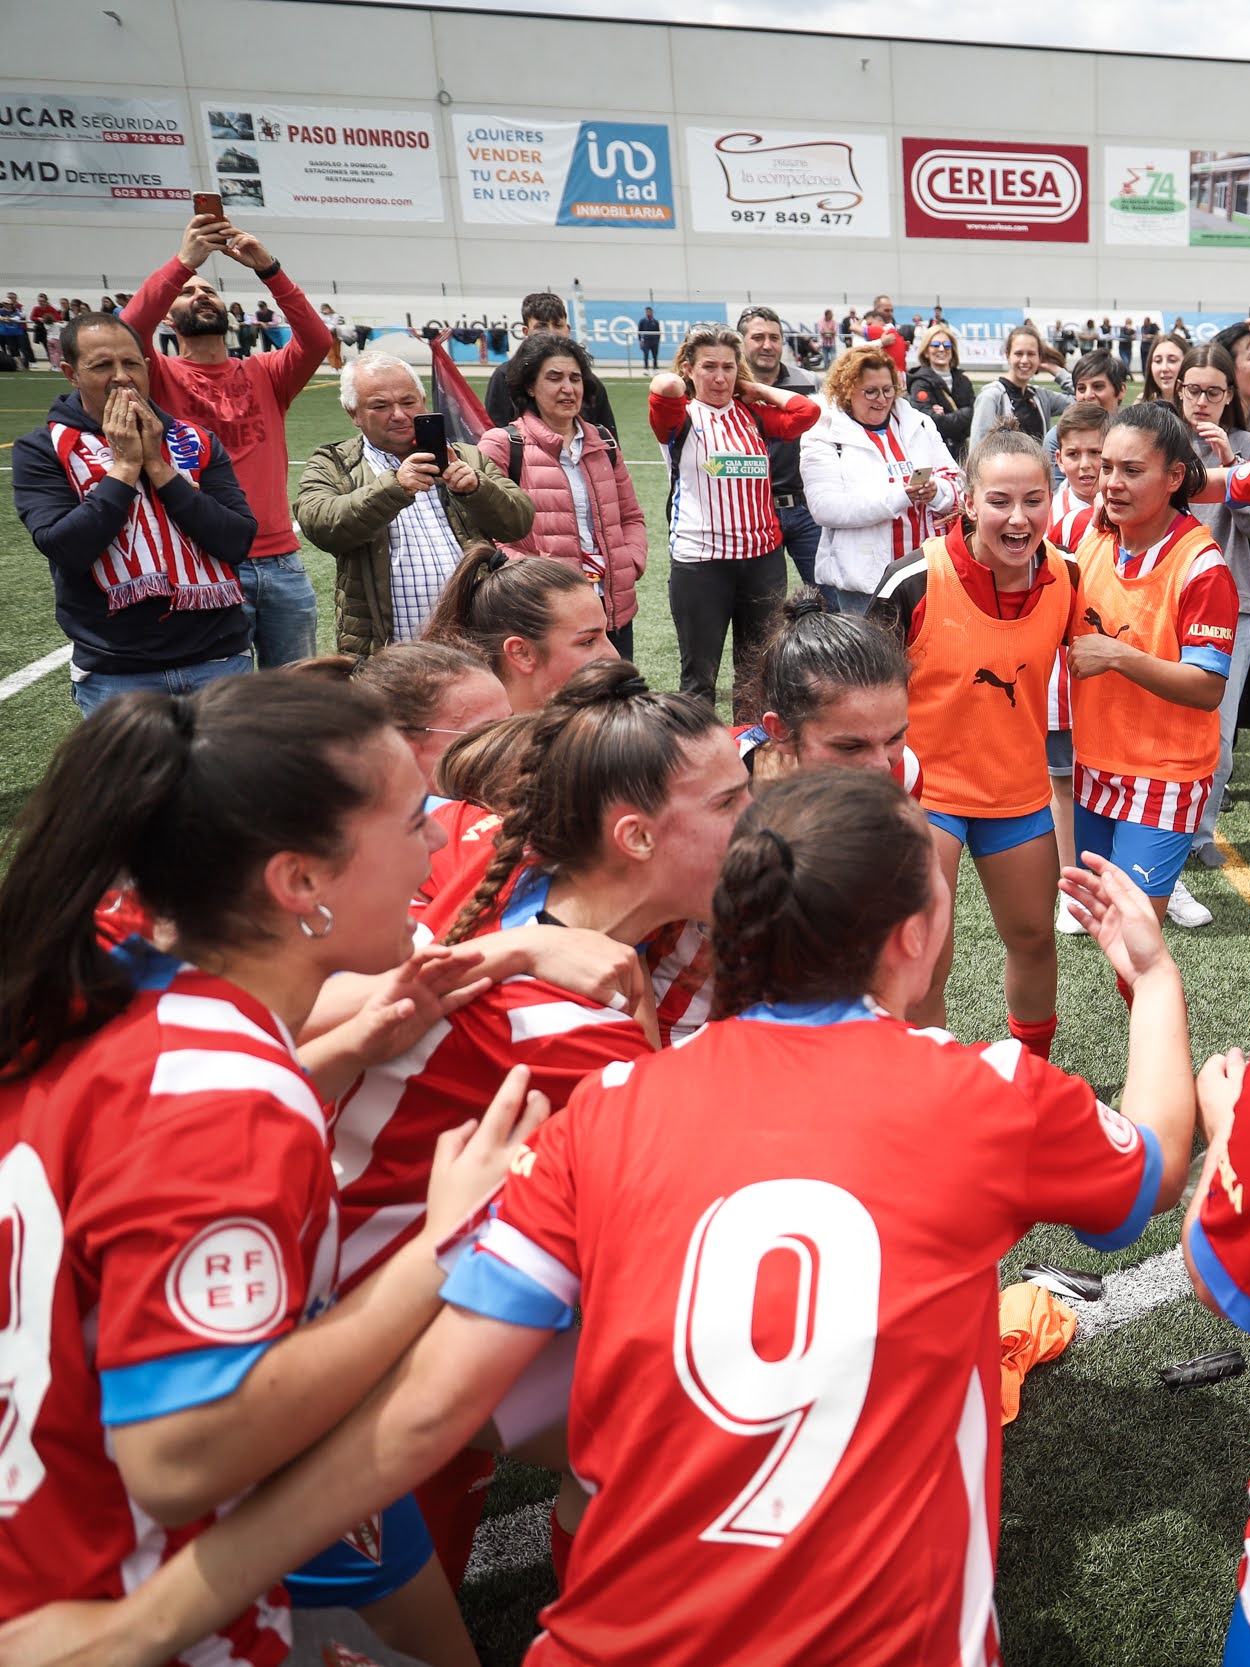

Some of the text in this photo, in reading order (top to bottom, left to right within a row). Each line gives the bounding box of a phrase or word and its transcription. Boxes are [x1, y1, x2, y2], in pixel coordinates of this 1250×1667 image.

[81, 115, 178, 131] SEGURIDAD
[159, 134, 183, 144] 963
[287, 124, 430, 149] PASO HONROSO
[466, 128, 544, 143] ¿QUIERES
[468, 147, 543, 163] VENDER
[65, 169, 162, 186] DETECTIVES
[470, 169, 544, 184] TU CASA
[473, 186, 550, 201] EN LEÓN?
[616, 179, 657, 200] iad
[927, 166, 1062, 207] CERLESA
[293, 194, 413, 206] www.pasohonroso.com
[576, 204, 666, 218] INMOBILIARIA
[731, 210, 853, 225] 987 849 477
[725, 460, 766, 468] CAJA RURAL
[1188, 623, 1233, 641] ALIMERK
[673, 1178, 882, 1549] 9
